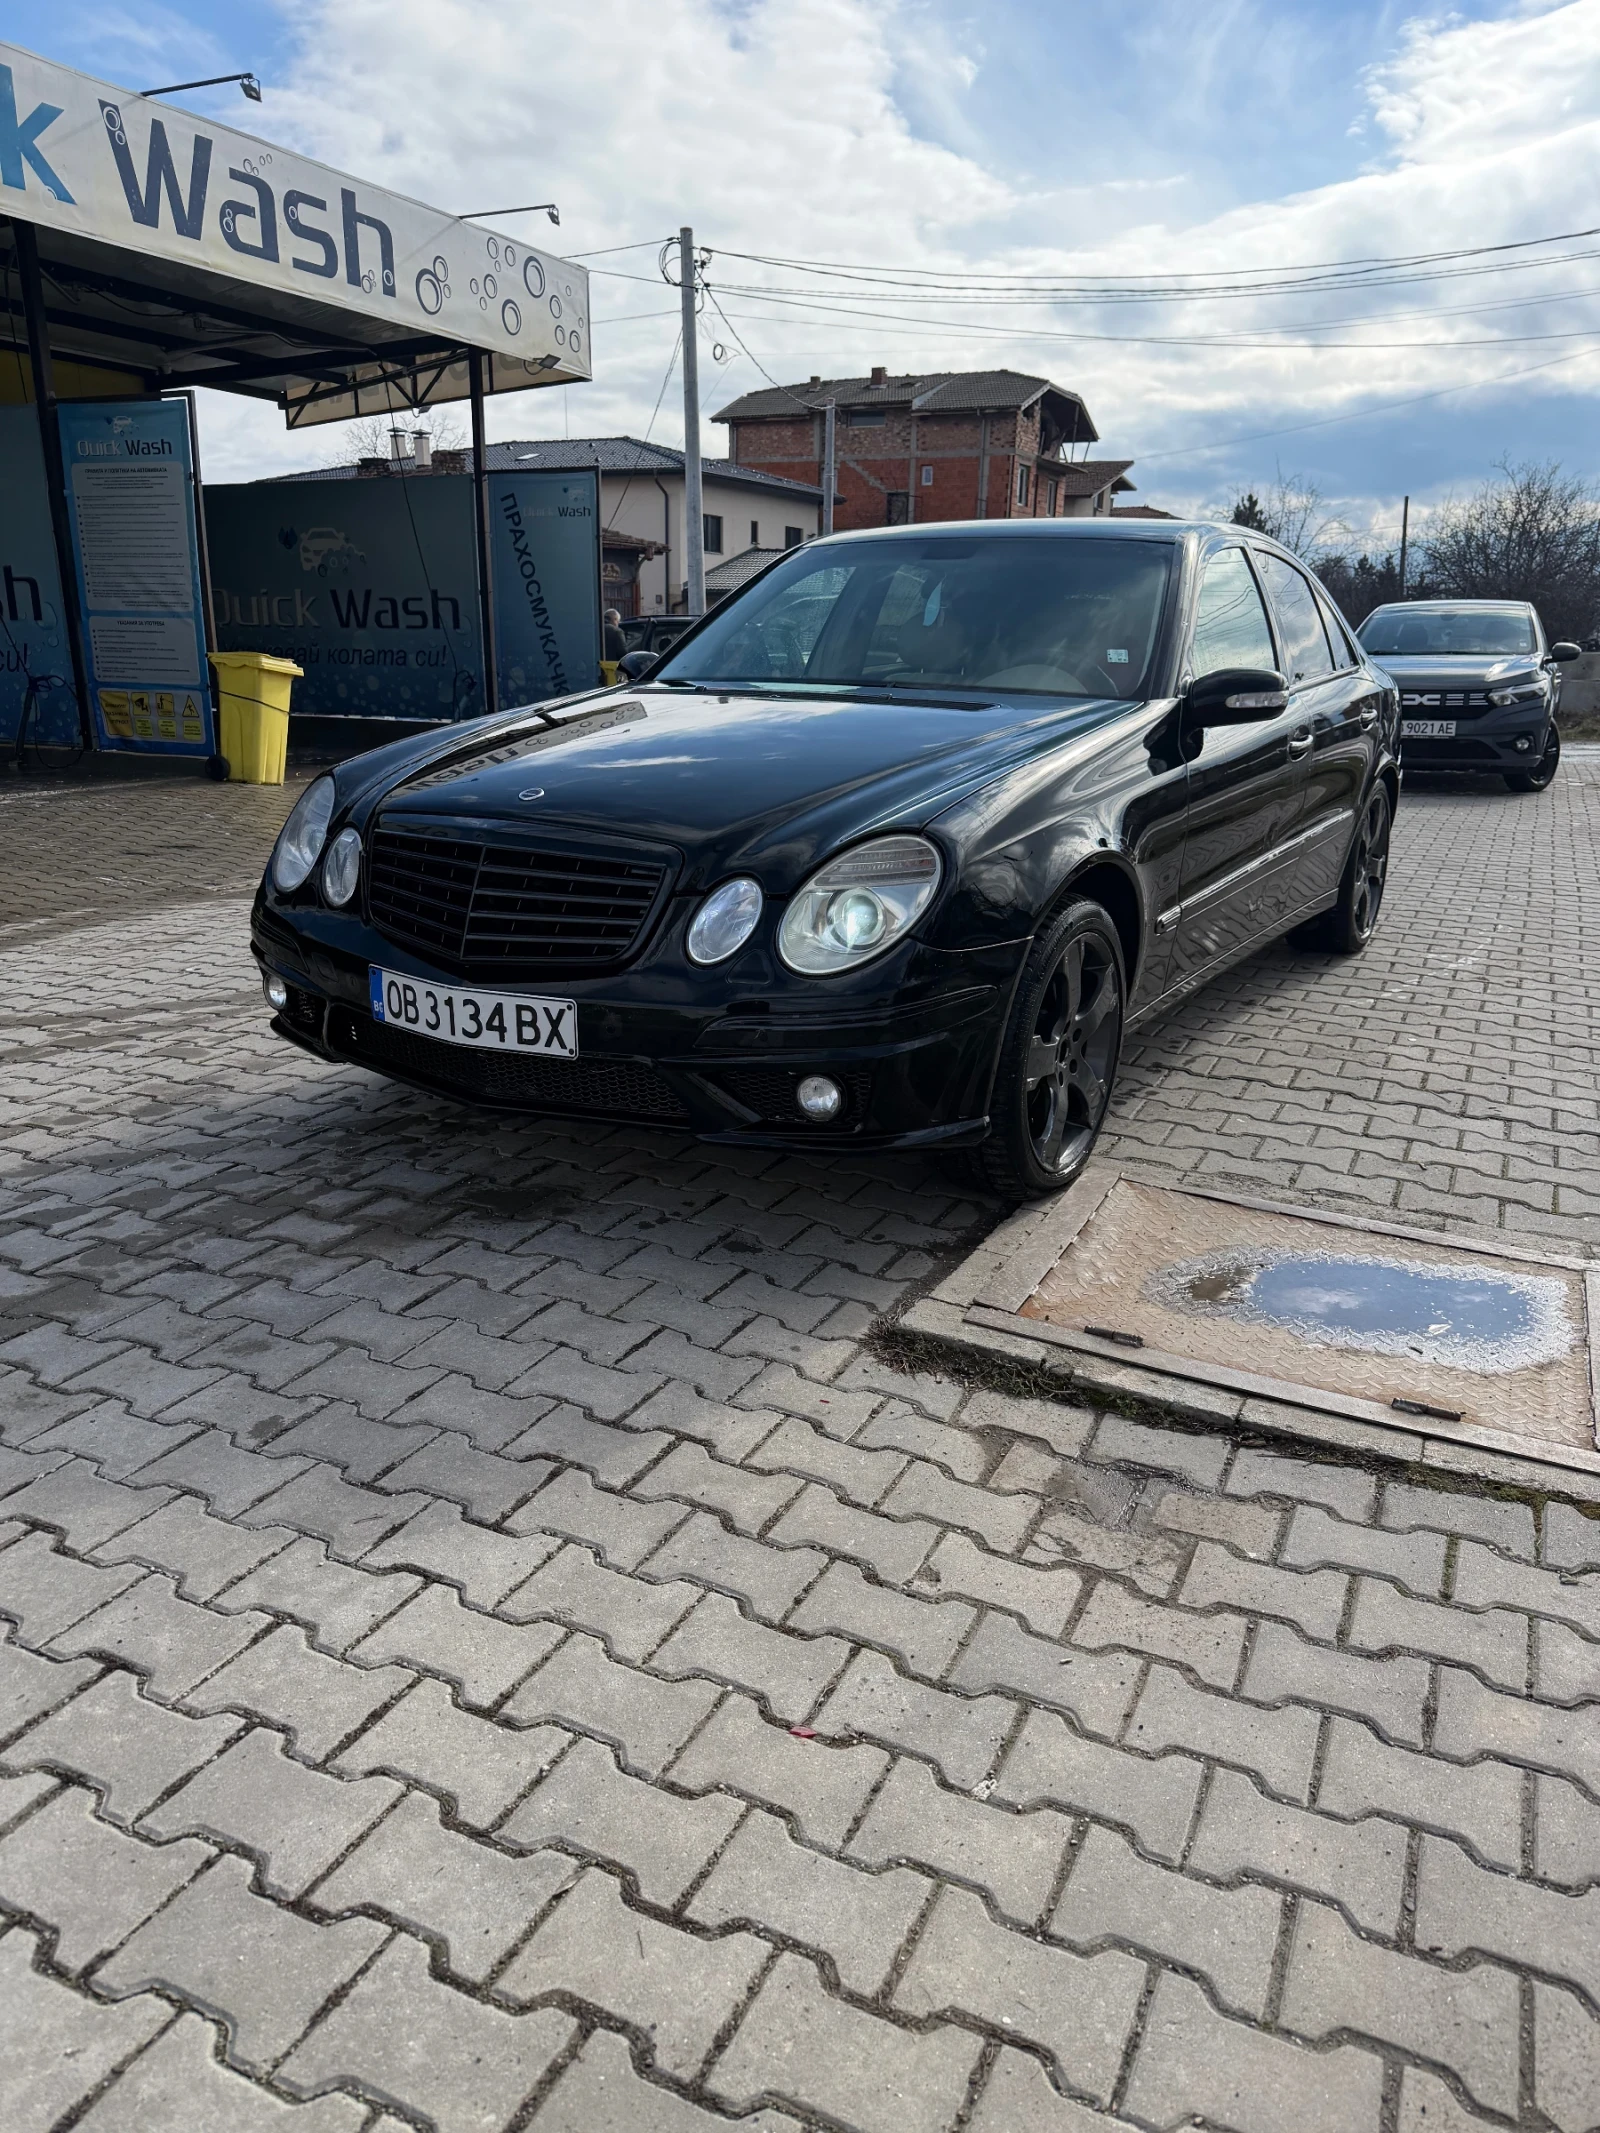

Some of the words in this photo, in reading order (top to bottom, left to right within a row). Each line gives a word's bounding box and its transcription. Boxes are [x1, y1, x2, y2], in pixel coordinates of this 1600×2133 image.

[97, 98, 397, 298] Wash
[77, 440, 123, 457] Quick
[125, 438, 172, 456] Wash
[557, 505, 591, 517] Wash
[211, 588, 321, 628] Quick
[329, 588, 460, 630] Wash
[327, 648, 407, 667] колата
[415, 645, 448, 668] си!
[373, 1000, 383, 1013] BG
